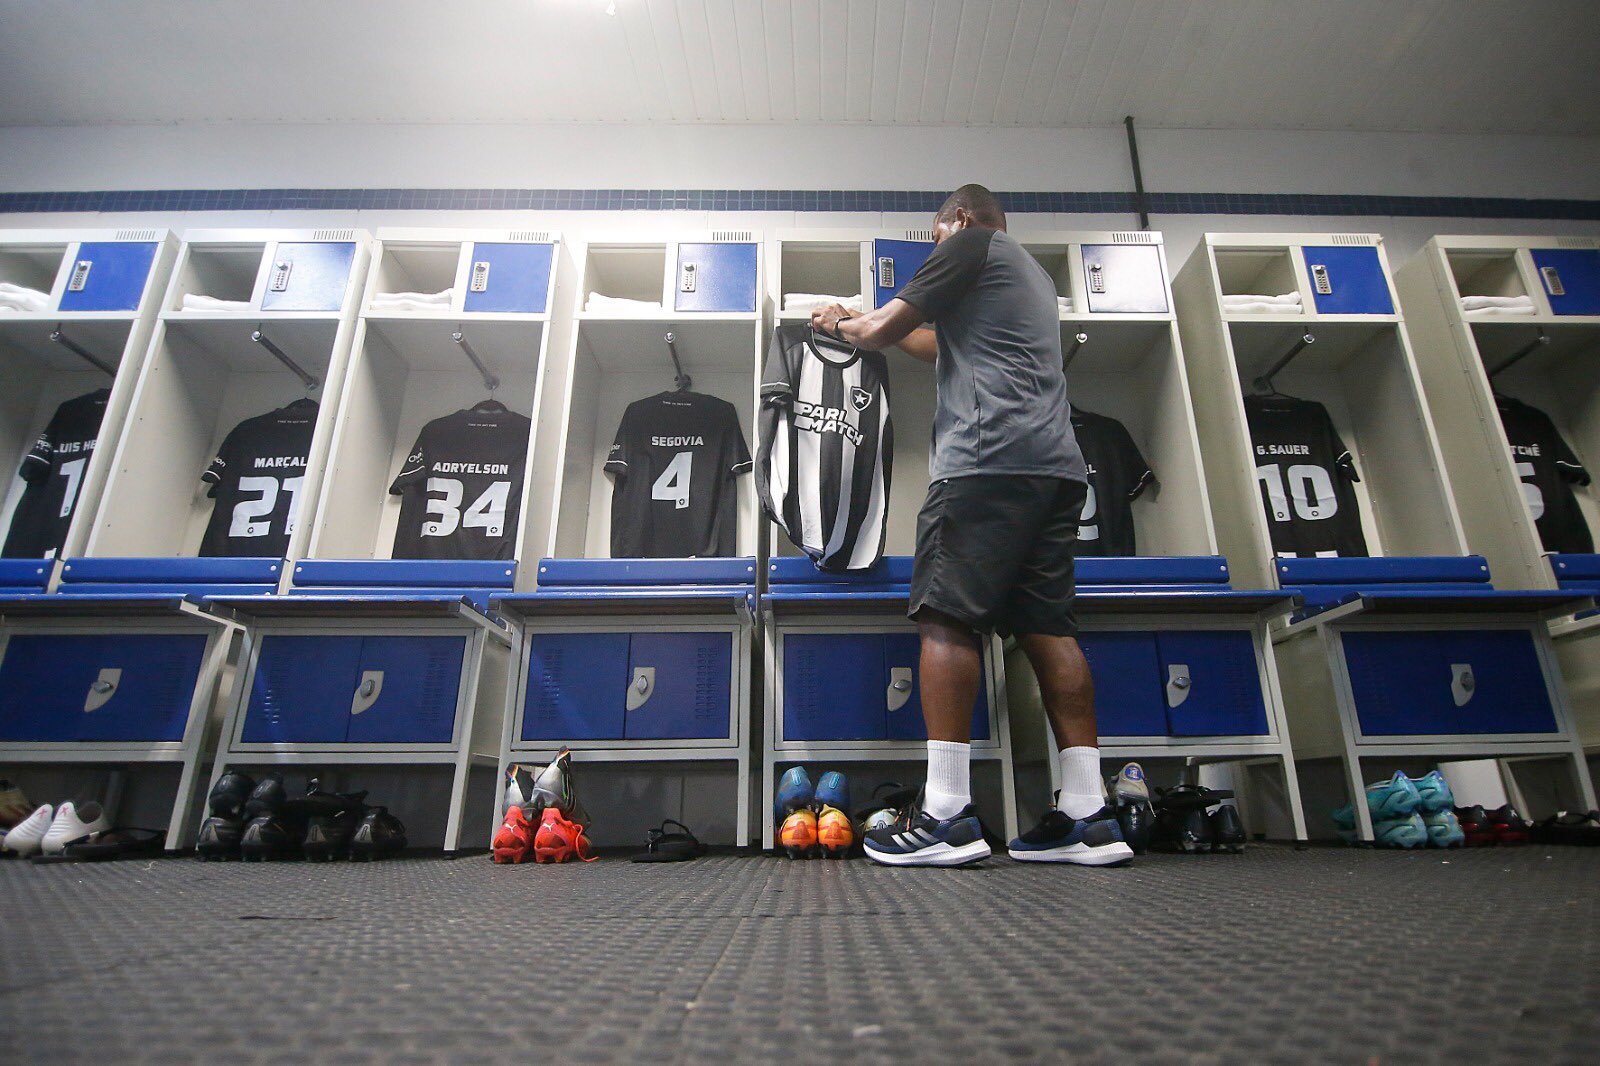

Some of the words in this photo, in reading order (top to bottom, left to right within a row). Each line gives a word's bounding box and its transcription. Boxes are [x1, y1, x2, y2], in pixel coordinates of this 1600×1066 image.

[793, 400, 846, 421] PARI
[651, 435, 704, 447] SEGOVIA
[793, 415, 864, 446] MATCH
[254, 456, 308, 469] MARÇAL
[1256, 444, 1310, 455] G.SAUER
[432, 462, 509, 475] ADRYELSON
[651, 451, 693, 510] 4
[59, 457, 87, 518] 1
[1256, 463, 1338, 522] 10
[228, 475, 305, 537] 21
[420, 477, 512, 538] 34
